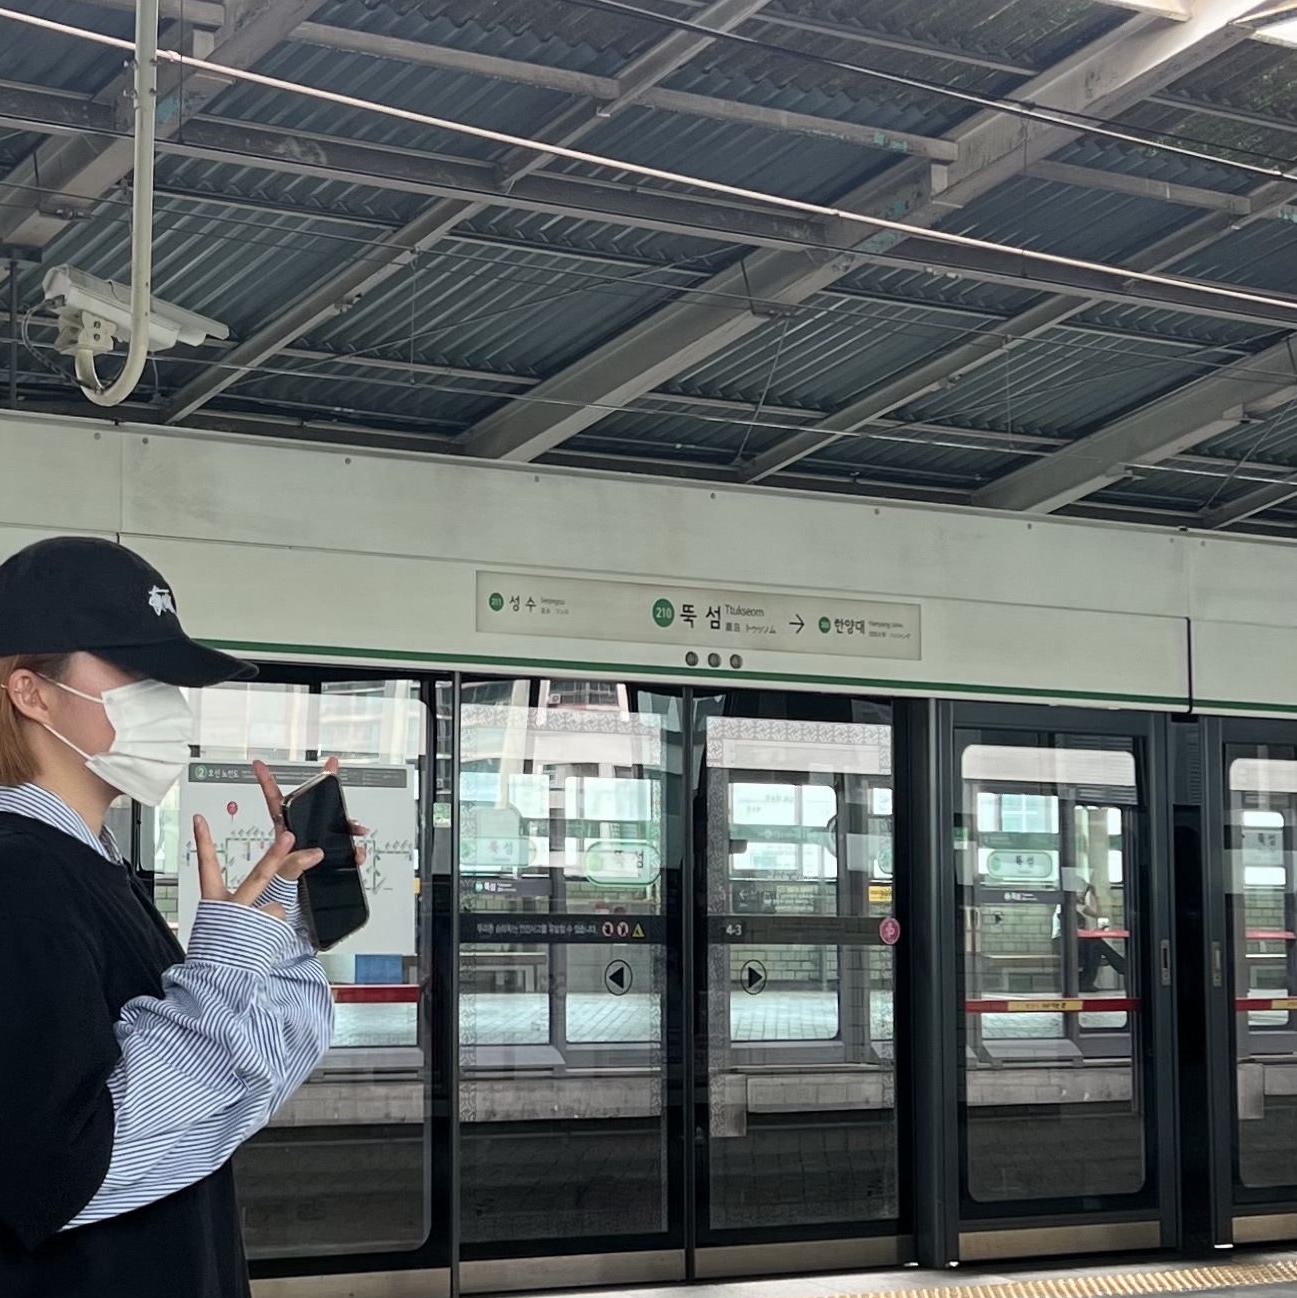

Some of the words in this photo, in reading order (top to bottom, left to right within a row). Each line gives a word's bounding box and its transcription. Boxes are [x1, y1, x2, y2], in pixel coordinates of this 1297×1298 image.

[509, 595, 537, 612] 성수
[725, 604, 765, 617] Ttukseom
[655, 607, 672, 619] 210
[680, 603, 721, 630] 뚝섬
[834, 618, 865, 635] 한양대
[725, 924, 742, 936] 4-3
